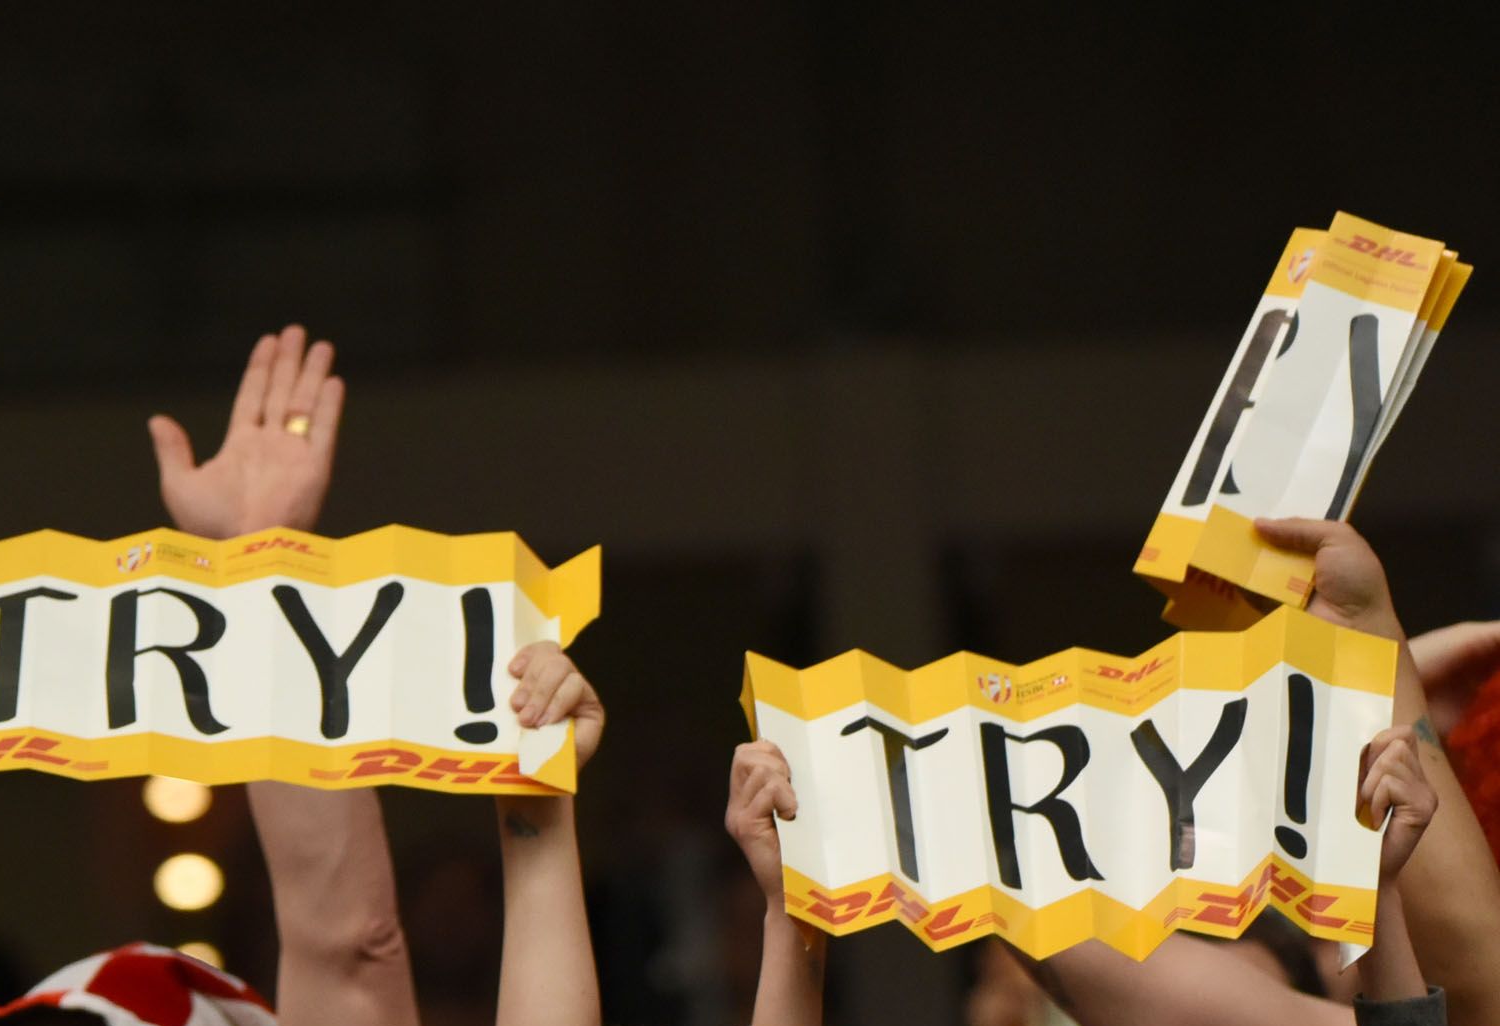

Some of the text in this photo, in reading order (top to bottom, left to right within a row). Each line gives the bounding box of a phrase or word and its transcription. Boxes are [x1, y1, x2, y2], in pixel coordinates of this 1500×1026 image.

[1348, 234, 1417, 268] DHL
[840, 673, 1315, 890] TRY!
[806, 881, 976, 942] DHL
[1193, 862, 1349, 928] DHL
